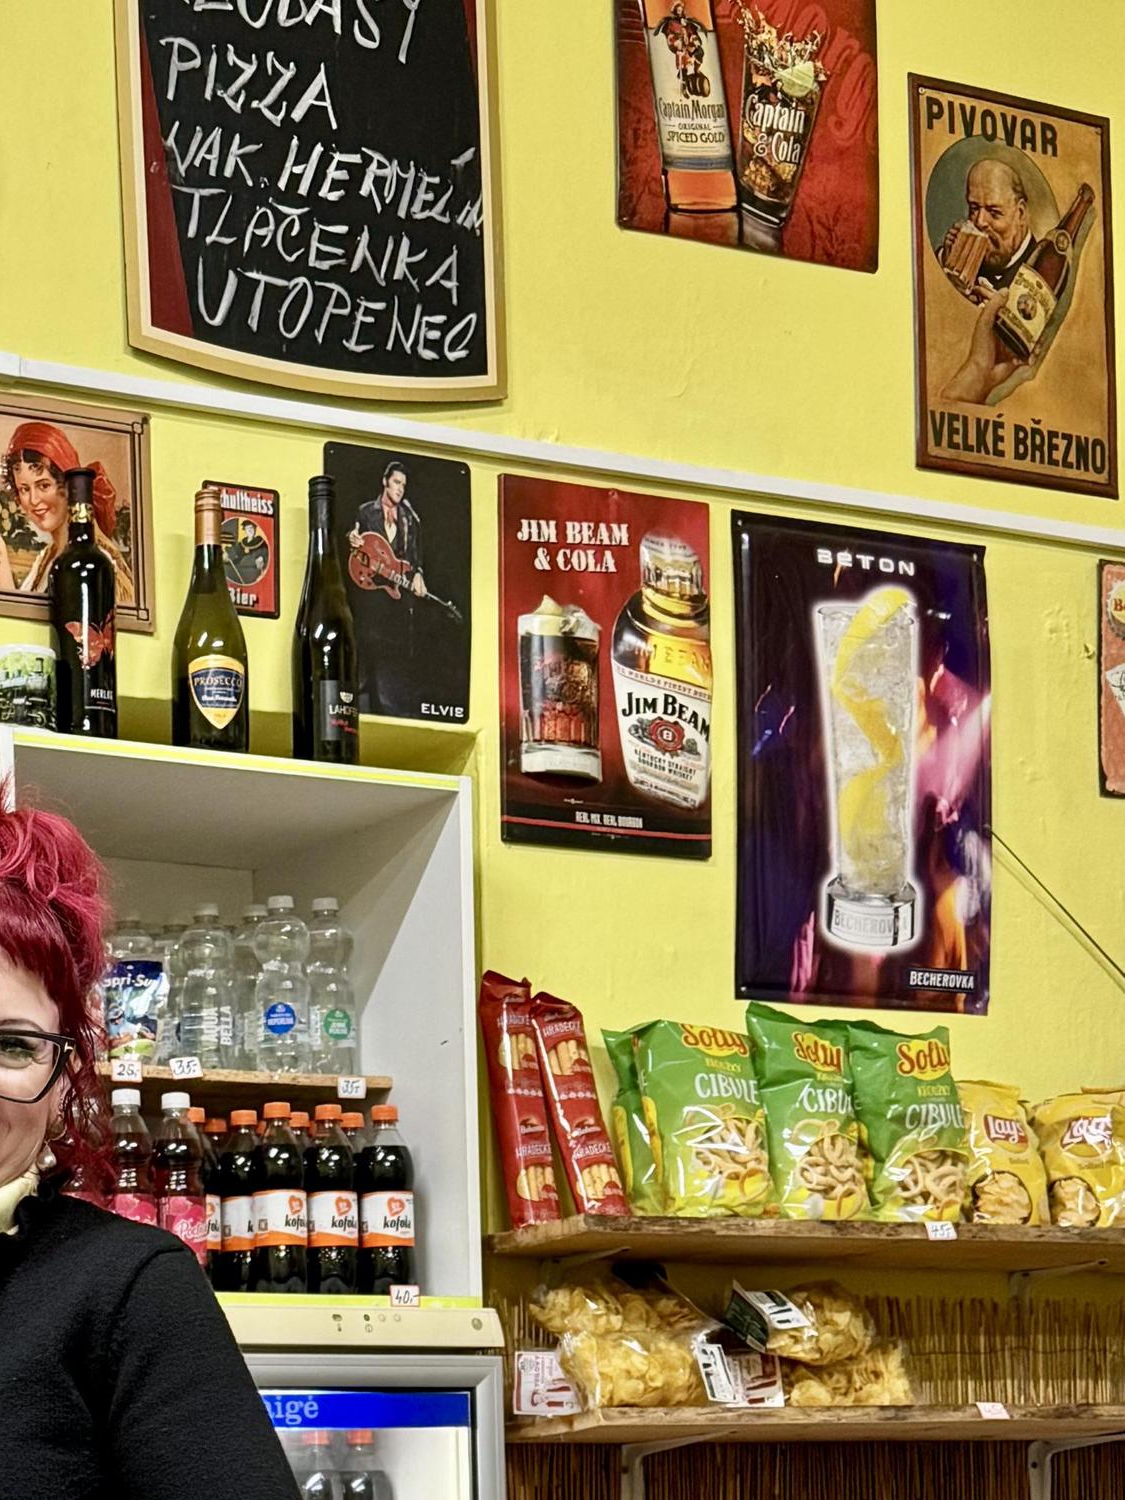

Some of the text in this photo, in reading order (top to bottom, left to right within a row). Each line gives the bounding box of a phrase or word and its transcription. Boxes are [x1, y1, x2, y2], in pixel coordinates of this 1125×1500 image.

[160, 36, 338, 130] PIZZA
[659, 97, 725, 122] Captain Morgan
[746, 93, 806, 134] Captain
[925, 95, 1060, 159] PIVOVAR
[666, 131, 725, 143] SPICED GOLD
[771, 131, 801, 163] Cola
[172, 183, 460, 305] TLAČENKA
[929, 408, 1107, 475] VELKÉ BŘEZNO
[517, 518, 558, 543] JIM
[565, 521, 629, 546] BEAM
[533, 547, 617, 573] & COLA
[420, 702, 465, 719] ELVIS
[622, 691, 711, 742] JIM BEAM
[909, 970, 974, 989] BECHEROVKA
[202, 1006, 219, 1043] AQUA
[220, 1005, 233, 1046] BELLA
